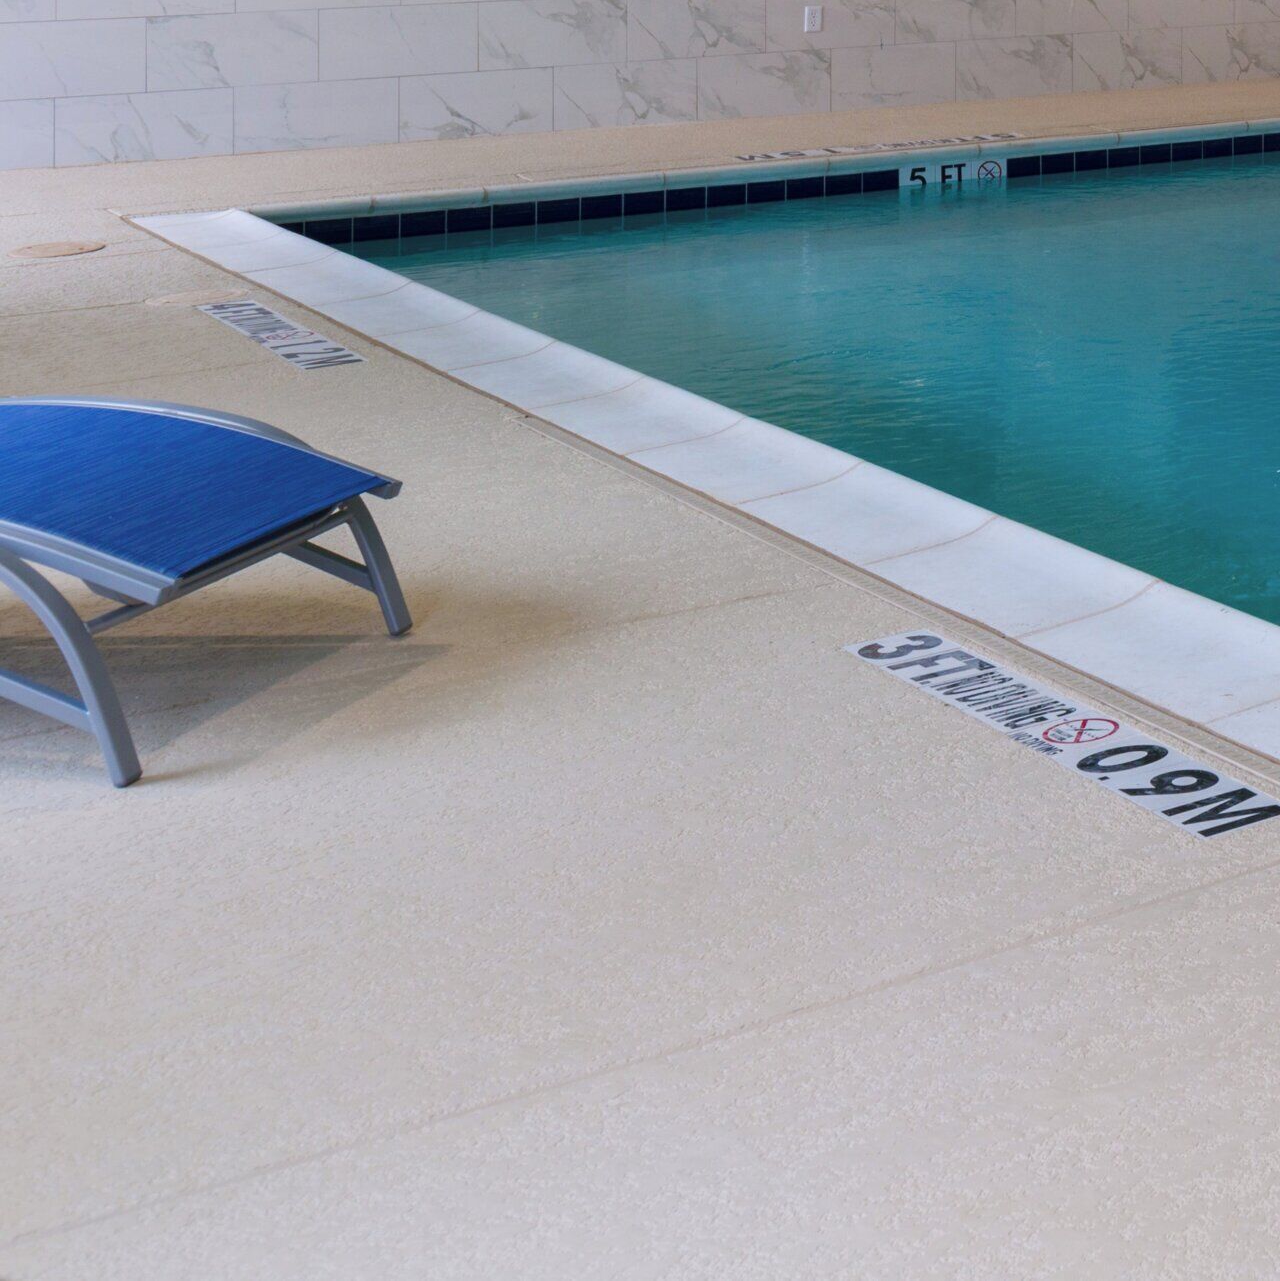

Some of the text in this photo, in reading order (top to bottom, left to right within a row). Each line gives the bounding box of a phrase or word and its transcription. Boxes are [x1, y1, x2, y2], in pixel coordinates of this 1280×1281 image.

[910, 163, 966, 185] 5 FT
[858, 634, 943, 660] 3
[930, 671, 1014, 696] NO
[955, 683, 1077, 729] DIVING
